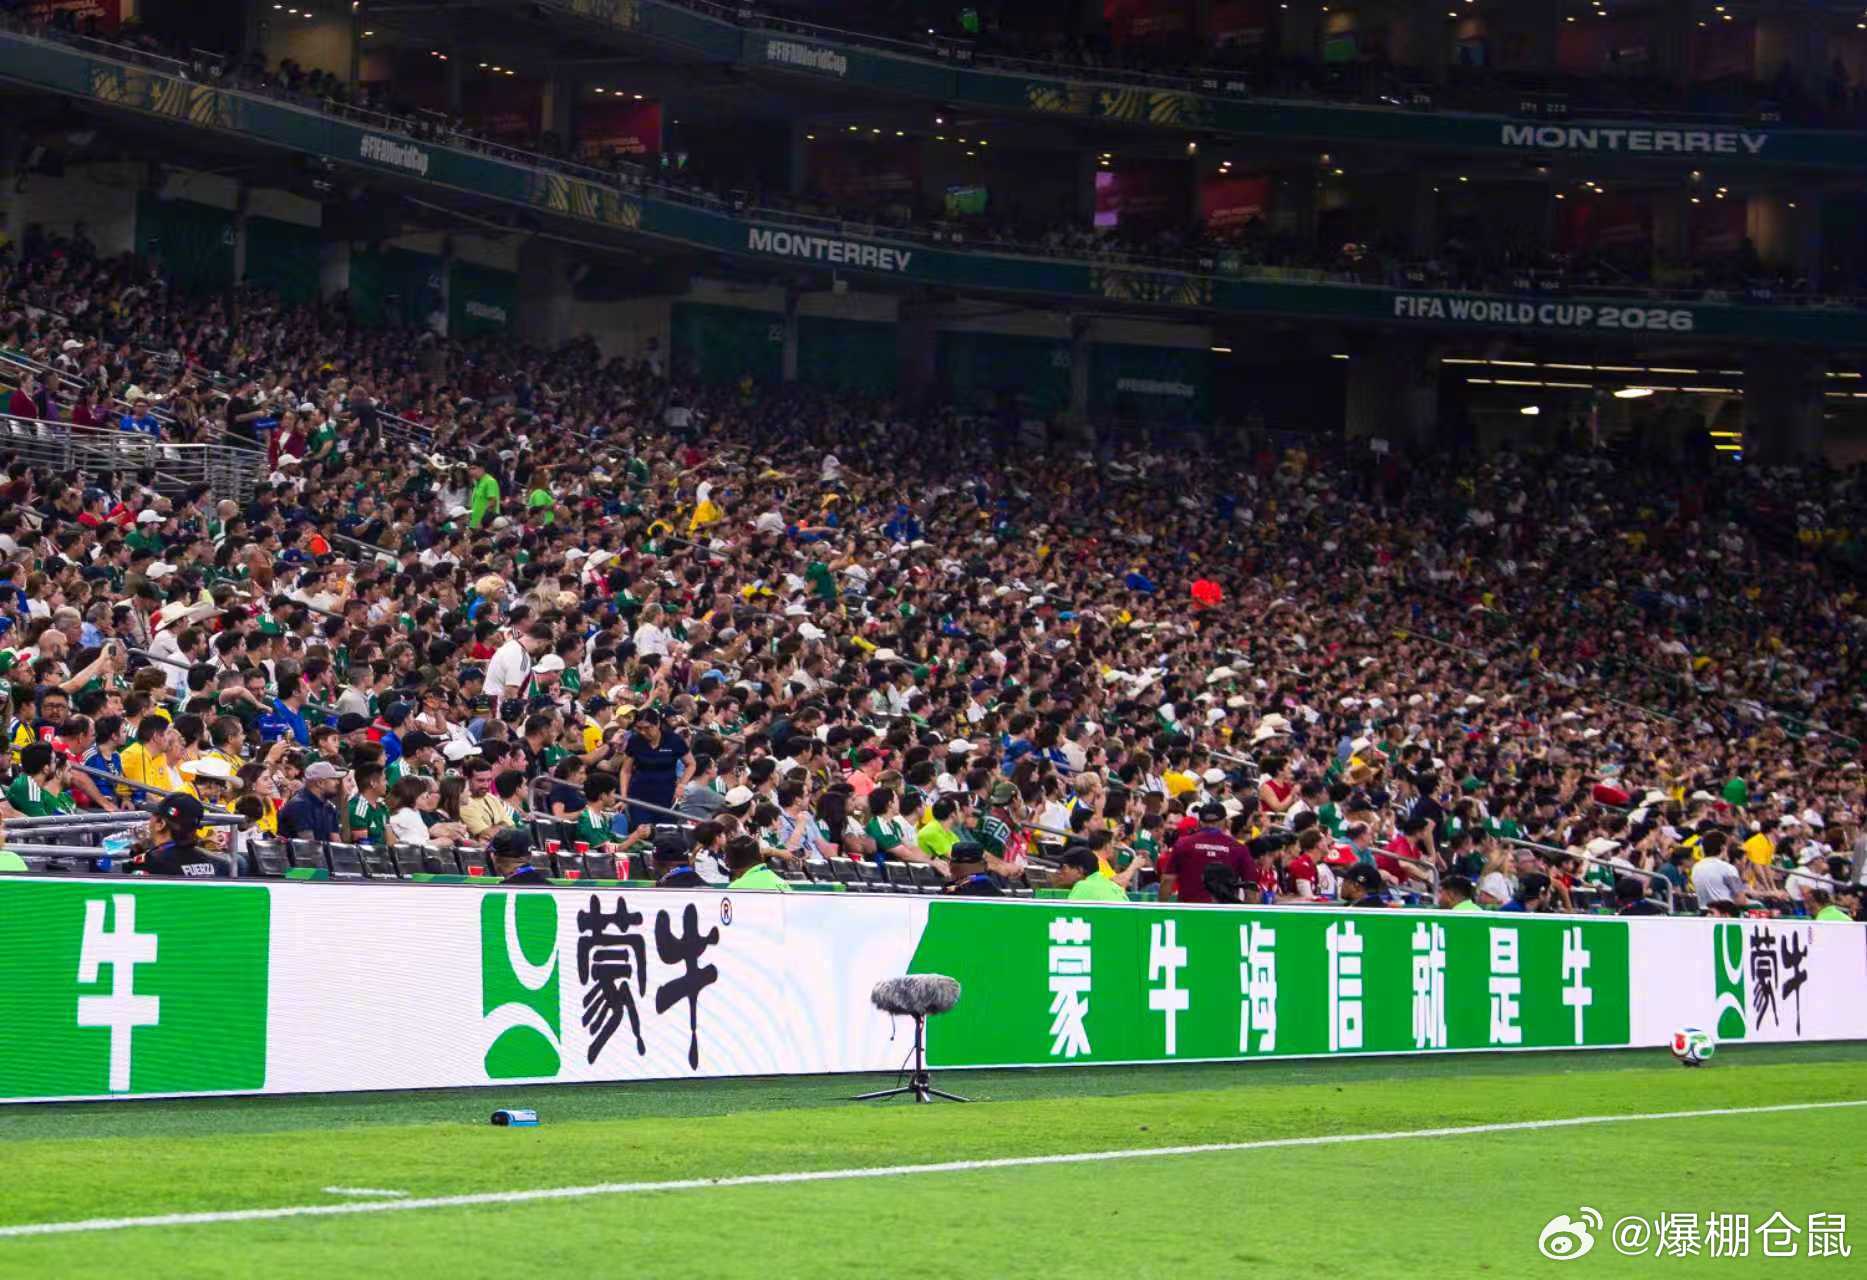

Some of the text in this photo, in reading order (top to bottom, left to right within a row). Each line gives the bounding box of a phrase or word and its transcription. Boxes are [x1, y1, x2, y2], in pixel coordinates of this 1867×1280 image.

[1501, 124, 1768, 153] MONTERREY
[748, 228, 912, 272] MONTERREY
[1394, 296, 1693, 331] FIFA WORLD CUP 2026
[77, 894, 160, 1091] 牛
[577, 893, 719, 1072] 蒙牛
[1048, 916, 1593, 1058] 蒙牛海信就是牛
[1750, 924, 1809, 1036] 蒙牛
